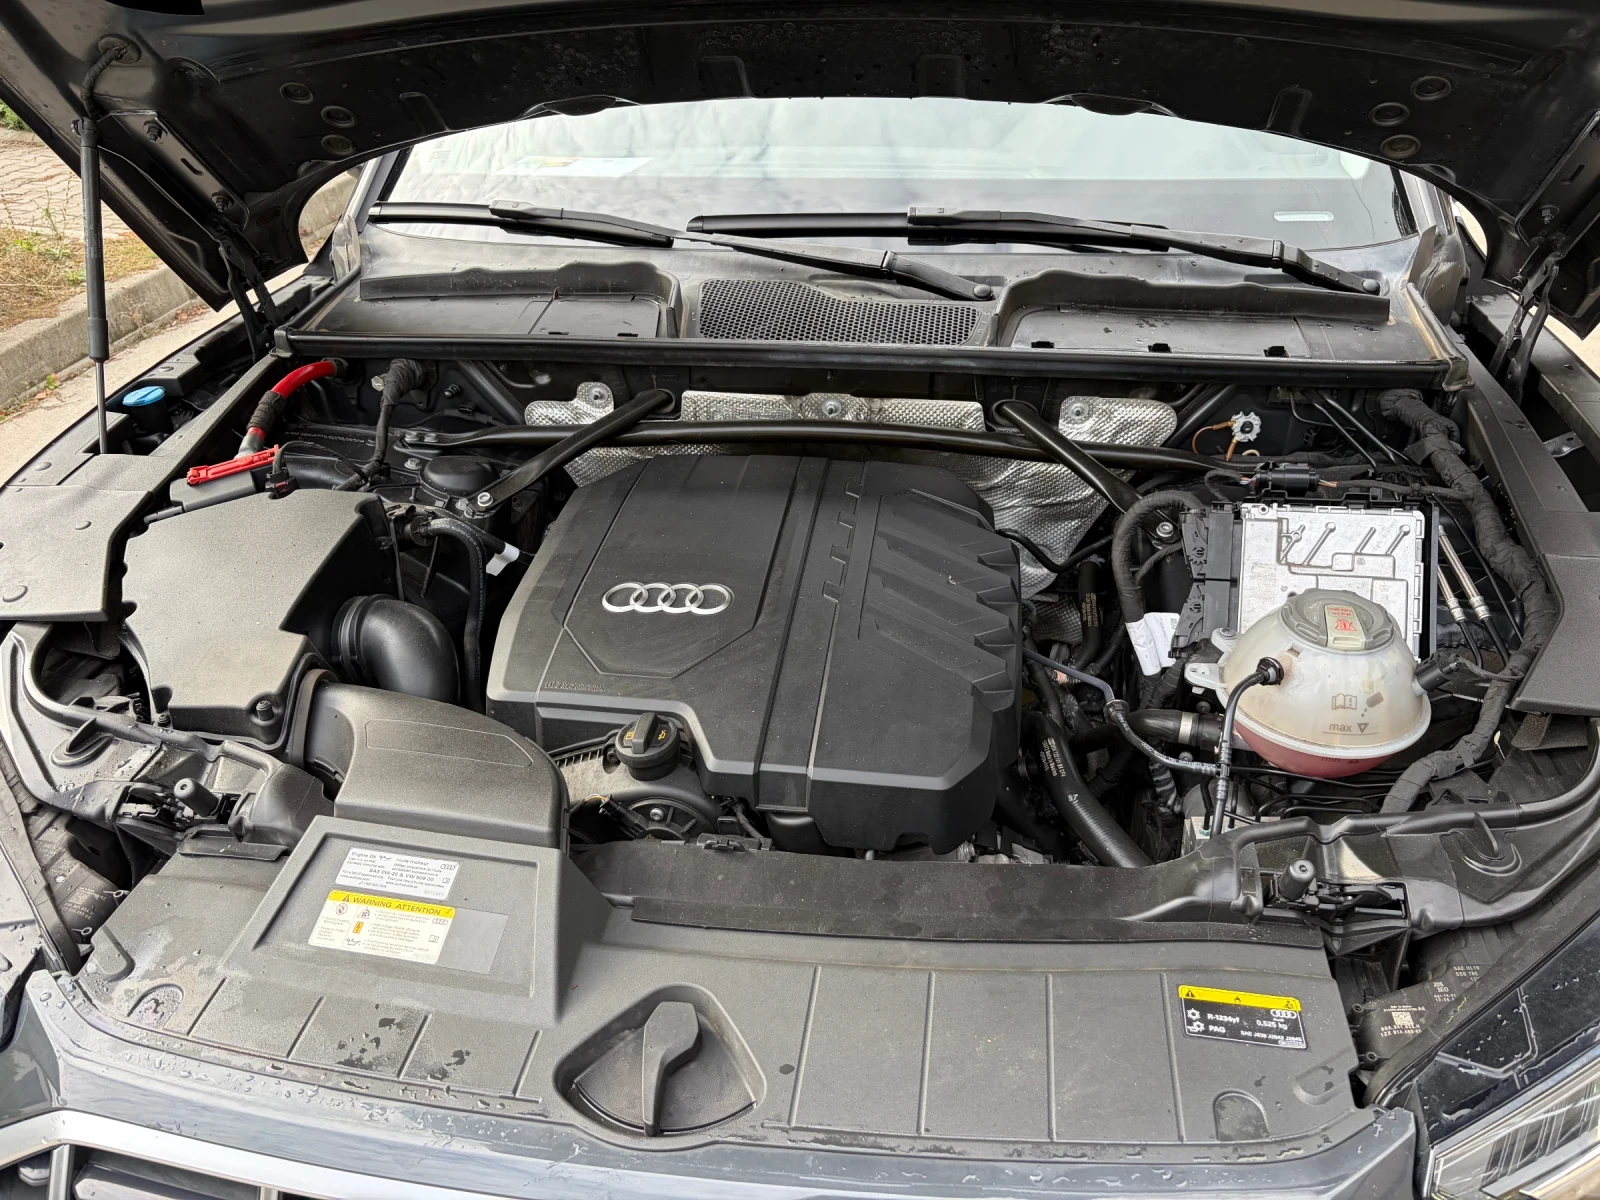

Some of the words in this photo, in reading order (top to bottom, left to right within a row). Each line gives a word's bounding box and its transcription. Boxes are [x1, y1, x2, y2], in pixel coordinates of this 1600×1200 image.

[1328, 723, 1353, 733] max
[353, 896, 393, 909] WARNING
[395, 903, 442, 916] ATTENTION
[1206, 1012, 1240, 1024] R-1234yf
[1208, 1024, 1227, 1034] PAG
[1256, 1019, 1277, 1028] 0,525
[1277, 1022, 1289, 1030] kg
